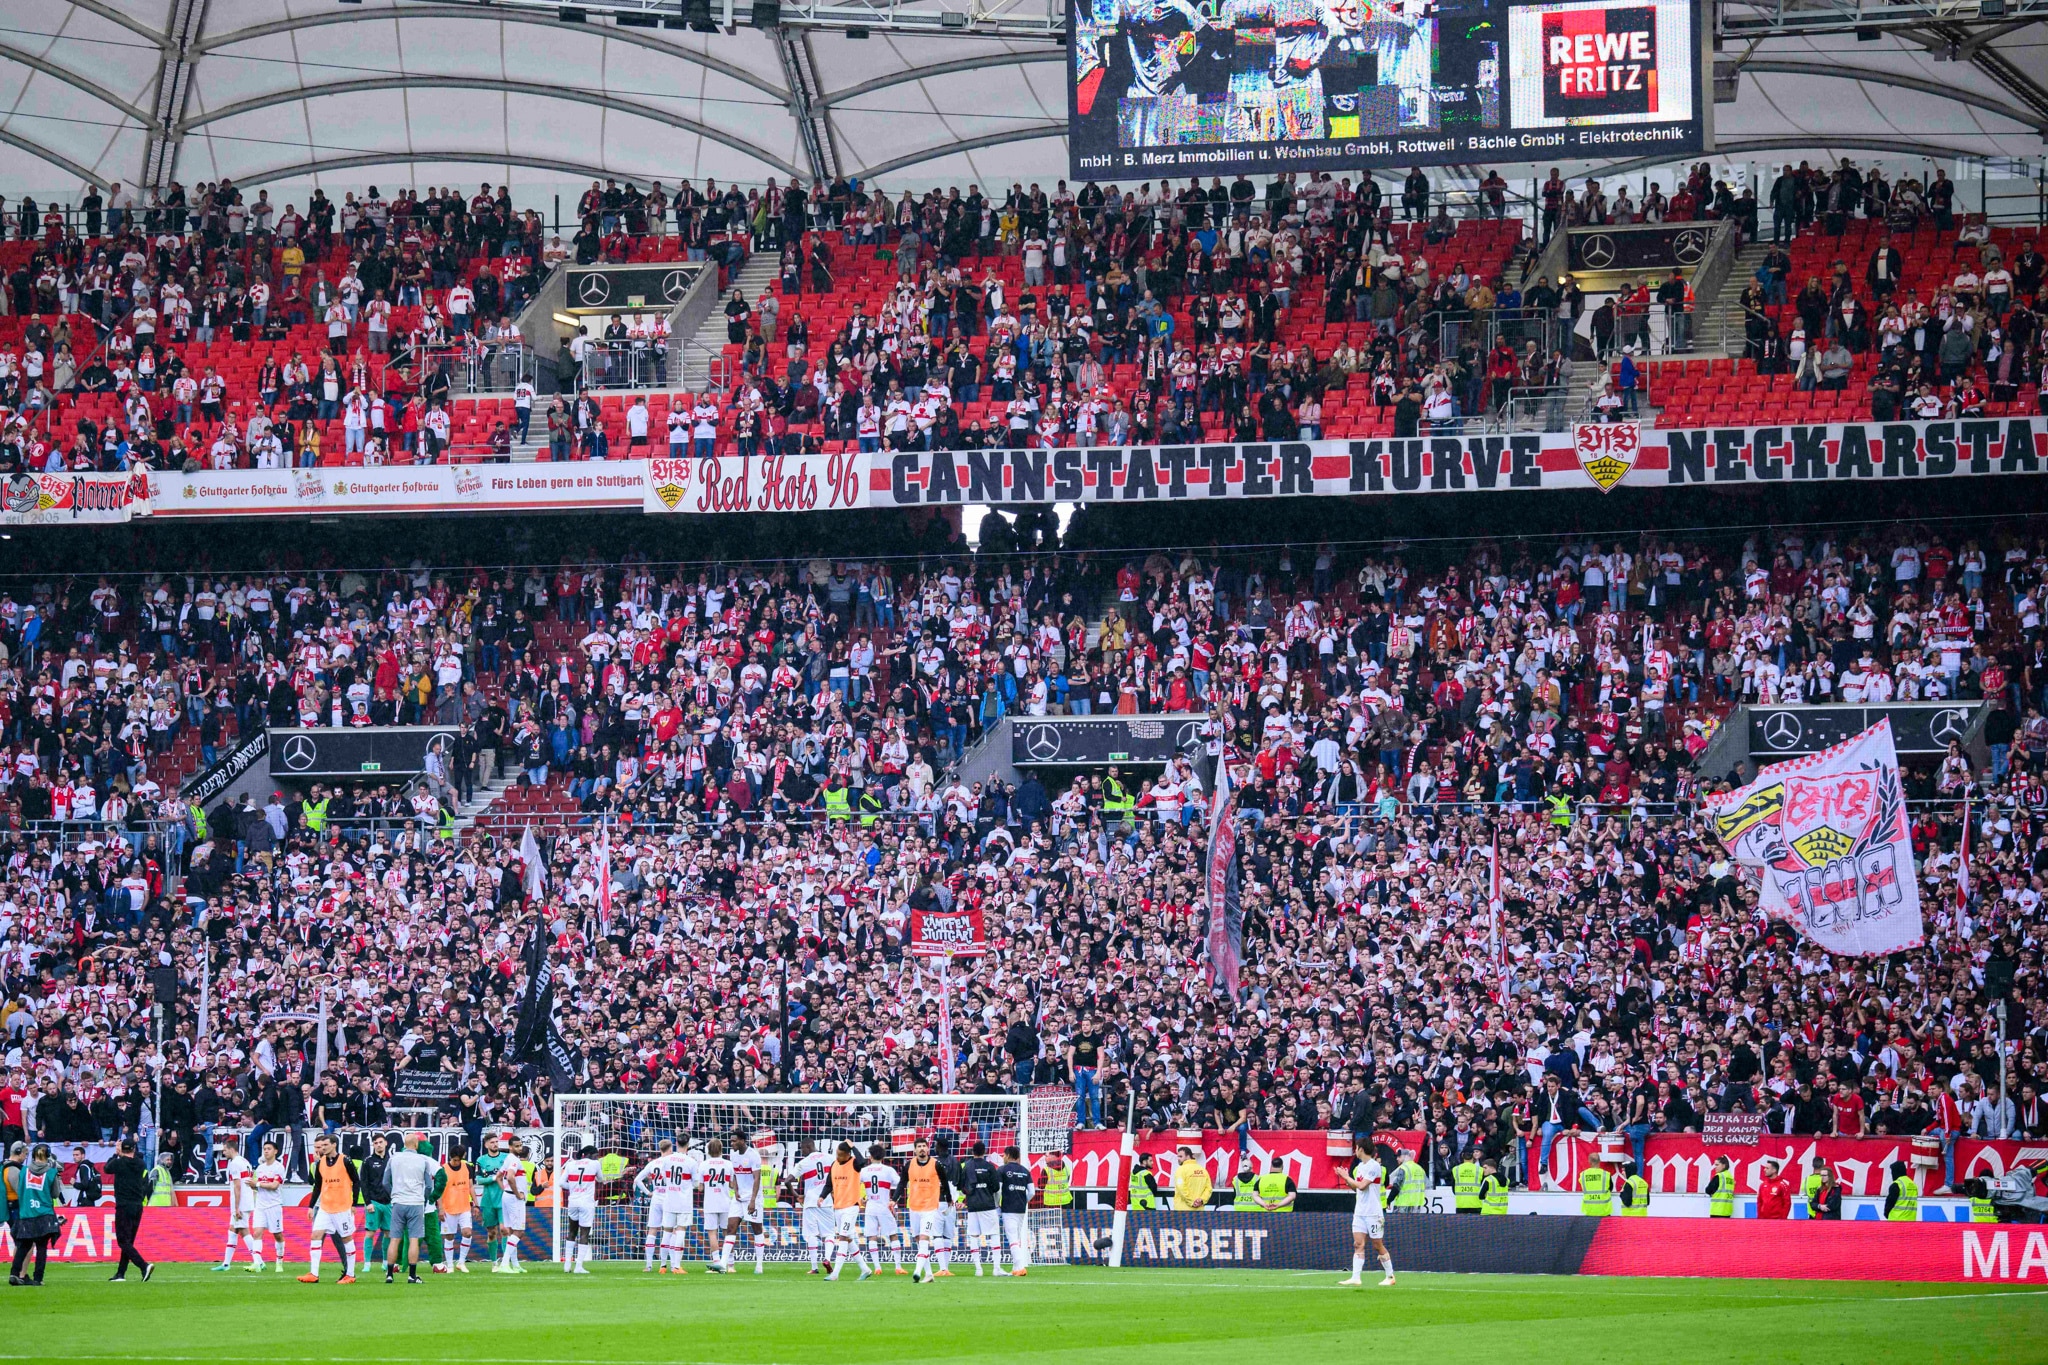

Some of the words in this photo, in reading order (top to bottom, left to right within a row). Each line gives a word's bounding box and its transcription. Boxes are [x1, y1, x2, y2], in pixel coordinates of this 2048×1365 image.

[1550, 31, 1650, 65] REWE
[1561, 64, 1642, 94] FRITZ
[1080, 154, 1111, 167] mbH
[1124, 153, 1138, 165] B.
[1142, 151, 1174, 165] Merz
[1178, 148, 1255, 163] Immobilien
[1259, 150, 1271, 160] u.
[1275, 144, 1341, 159] Wohnbau
[1345, 141, 1393, 156] GmbH,
[1398, 137, 1455, 153] Rottweil
[1468, 135, 1517, 150] Bächle
[1521, 132, 1565, 147] GmbH
[1579, 128, 1684, 145] Elektrotechnik
[892, 443, 1313, 504] CANNSTATTER
[1350, 436, 1541, 491] KURVE
[350, 483, 400, 497] Stuttgarter
[402, 482, 439, 495] Hofbräu
[492, 477, 514, 490] Fürs
[517, 477, 547, 489] Leben
[550, 477, 574, 489] gern
[577, 476, 593, 487] ein
[698, 456, 752, 512] Red
[758, 454, 818, 511] Hots
[827, 453, 859, 508] 96
[199, 485, 249, 499] Stuttgarter
[251, 484, 288, 498] Hofbräu
[30, 512, 60, 525] 2005
[921, 914, 970, 929] KÄMPFEN
[921, 927, 974, 945] STUTTGART
[1704, 1114, 1740, 1123] ULTRA
[1703, 1125, 1723, 1133] DER
[1702, 1134, 1723, 1144] UMS
[1725, 1134, 1759, 1145] GANZE
[577, 1168, 585, 1184] 7
[671, 1165, 683, 1186] 16
[709, 1168, 726, 1187] 24
[816, 1162, 824, 1180] 9
[871, 1175, 879, 1195] 8
[30, 1199, 40, 1208] 30
[342, 1222, 348, 1231] 15
[1132, 1228, 1268, 1260] ARBEIT
[733, 1249, 826, 1262] Meredes-Bn
